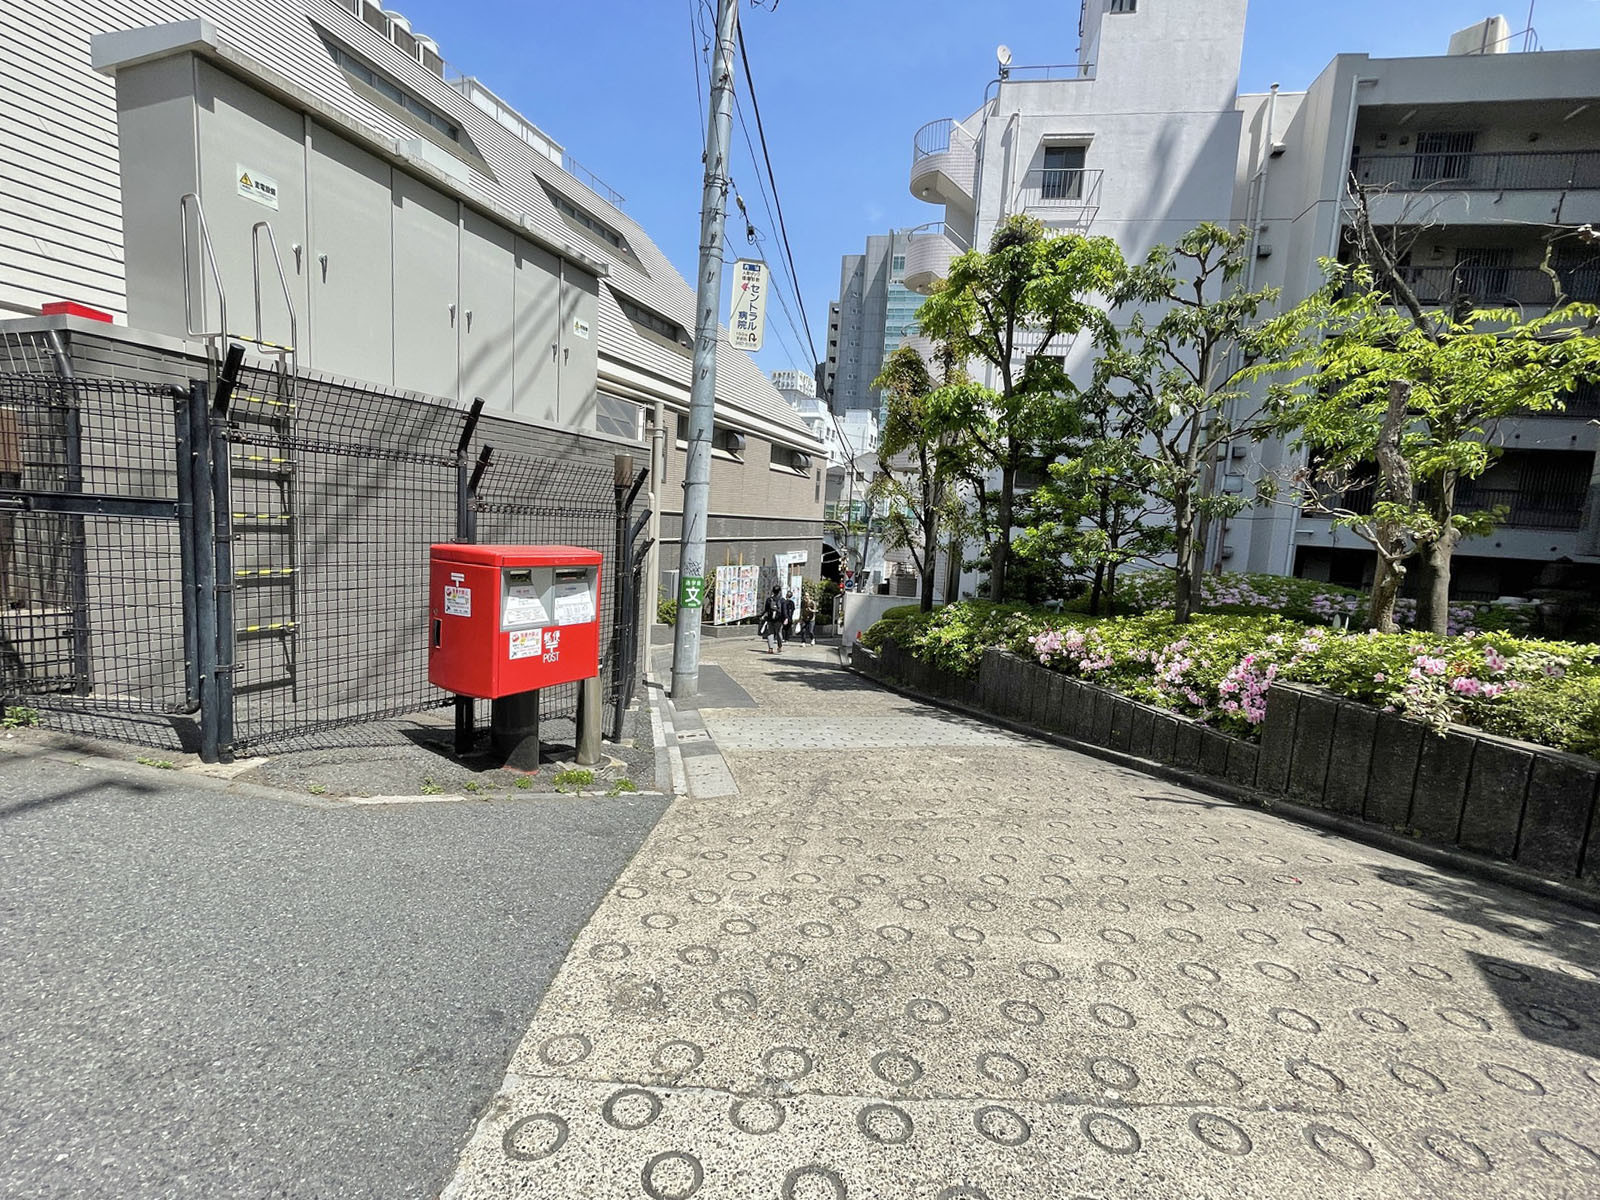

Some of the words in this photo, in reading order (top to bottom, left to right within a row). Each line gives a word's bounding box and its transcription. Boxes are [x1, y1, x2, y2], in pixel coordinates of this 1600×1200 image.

[748, 284, 760, 331] セントラル
[737, 311, 748, 330] 病院
[543, 631, 560, 644] 郵便
[543, 652, 559, 663] POST
